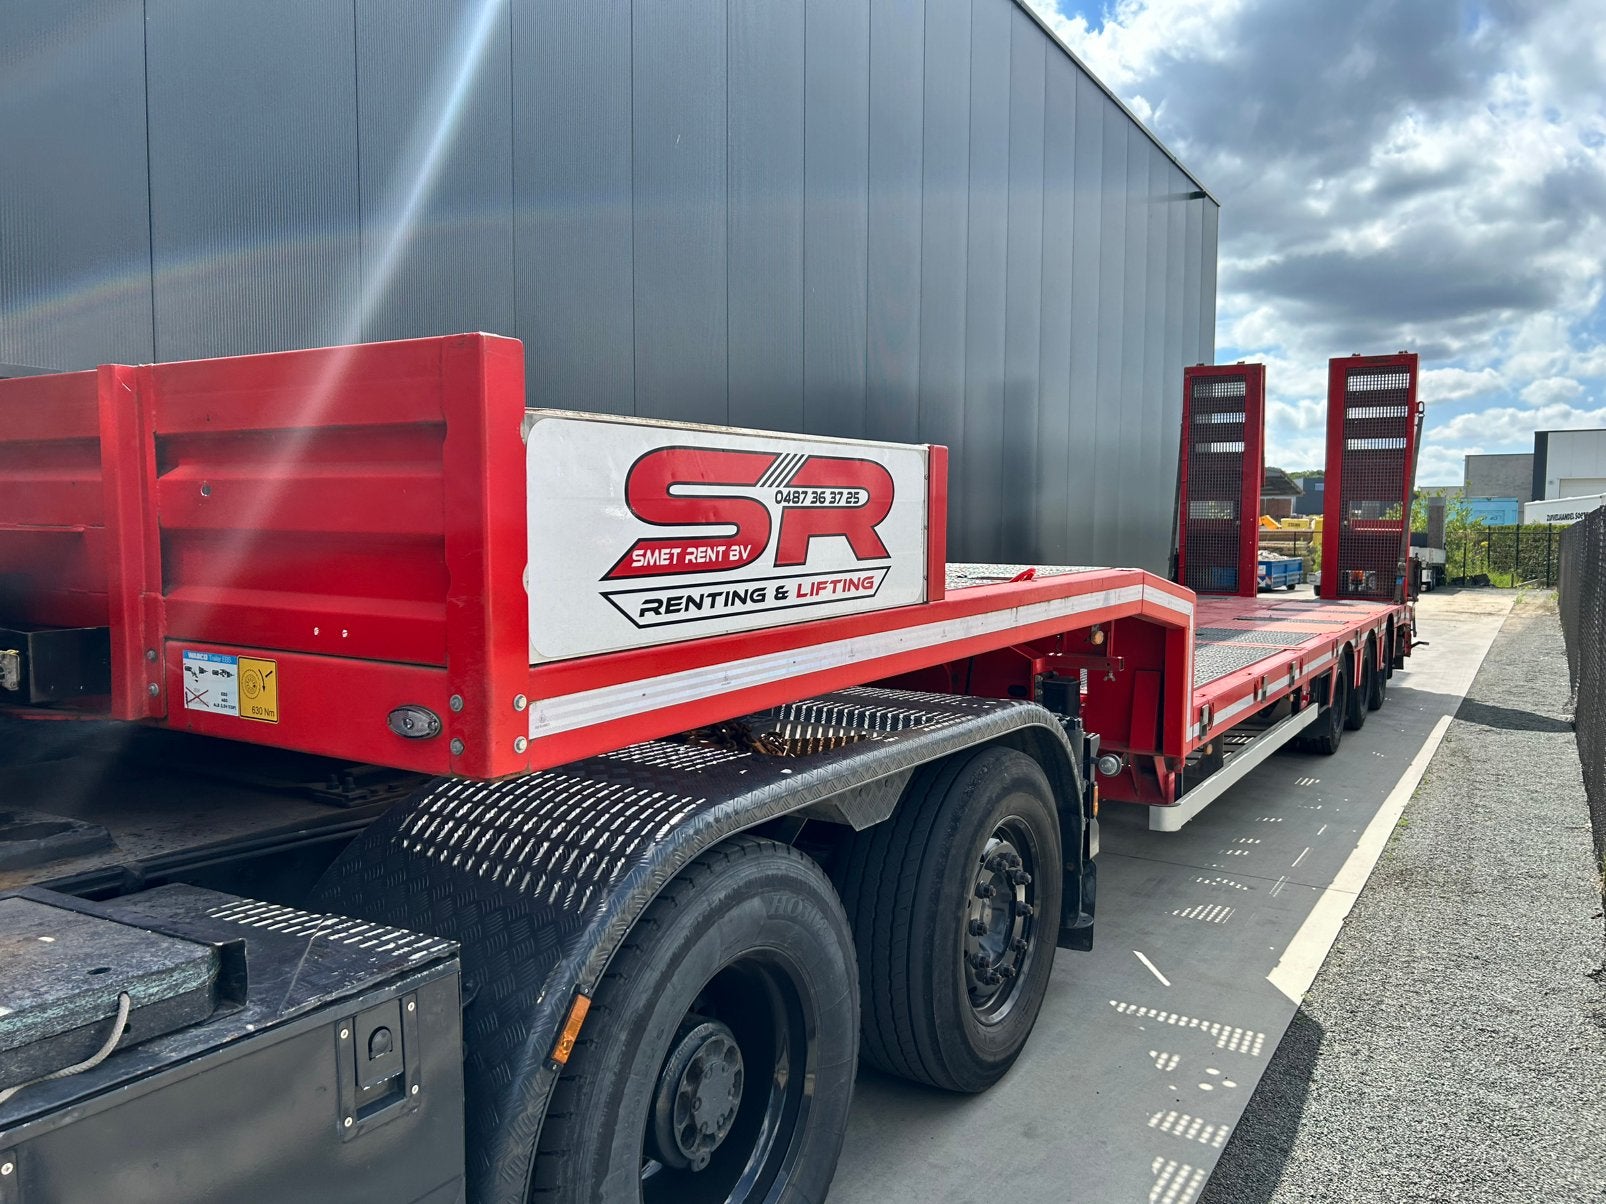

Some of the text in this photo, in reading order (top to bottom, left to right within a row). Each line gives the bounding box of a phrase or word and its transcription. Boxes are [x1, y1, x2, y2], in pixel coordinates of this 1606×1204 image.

[774, 488, 860, 506] 0487 36 37 25
[631, 544, 752, 567] SMET RENT BV
[638, 575, 876, 618] RENTING & LIFTING
[251, 705, 275, 717] 630 Nm
